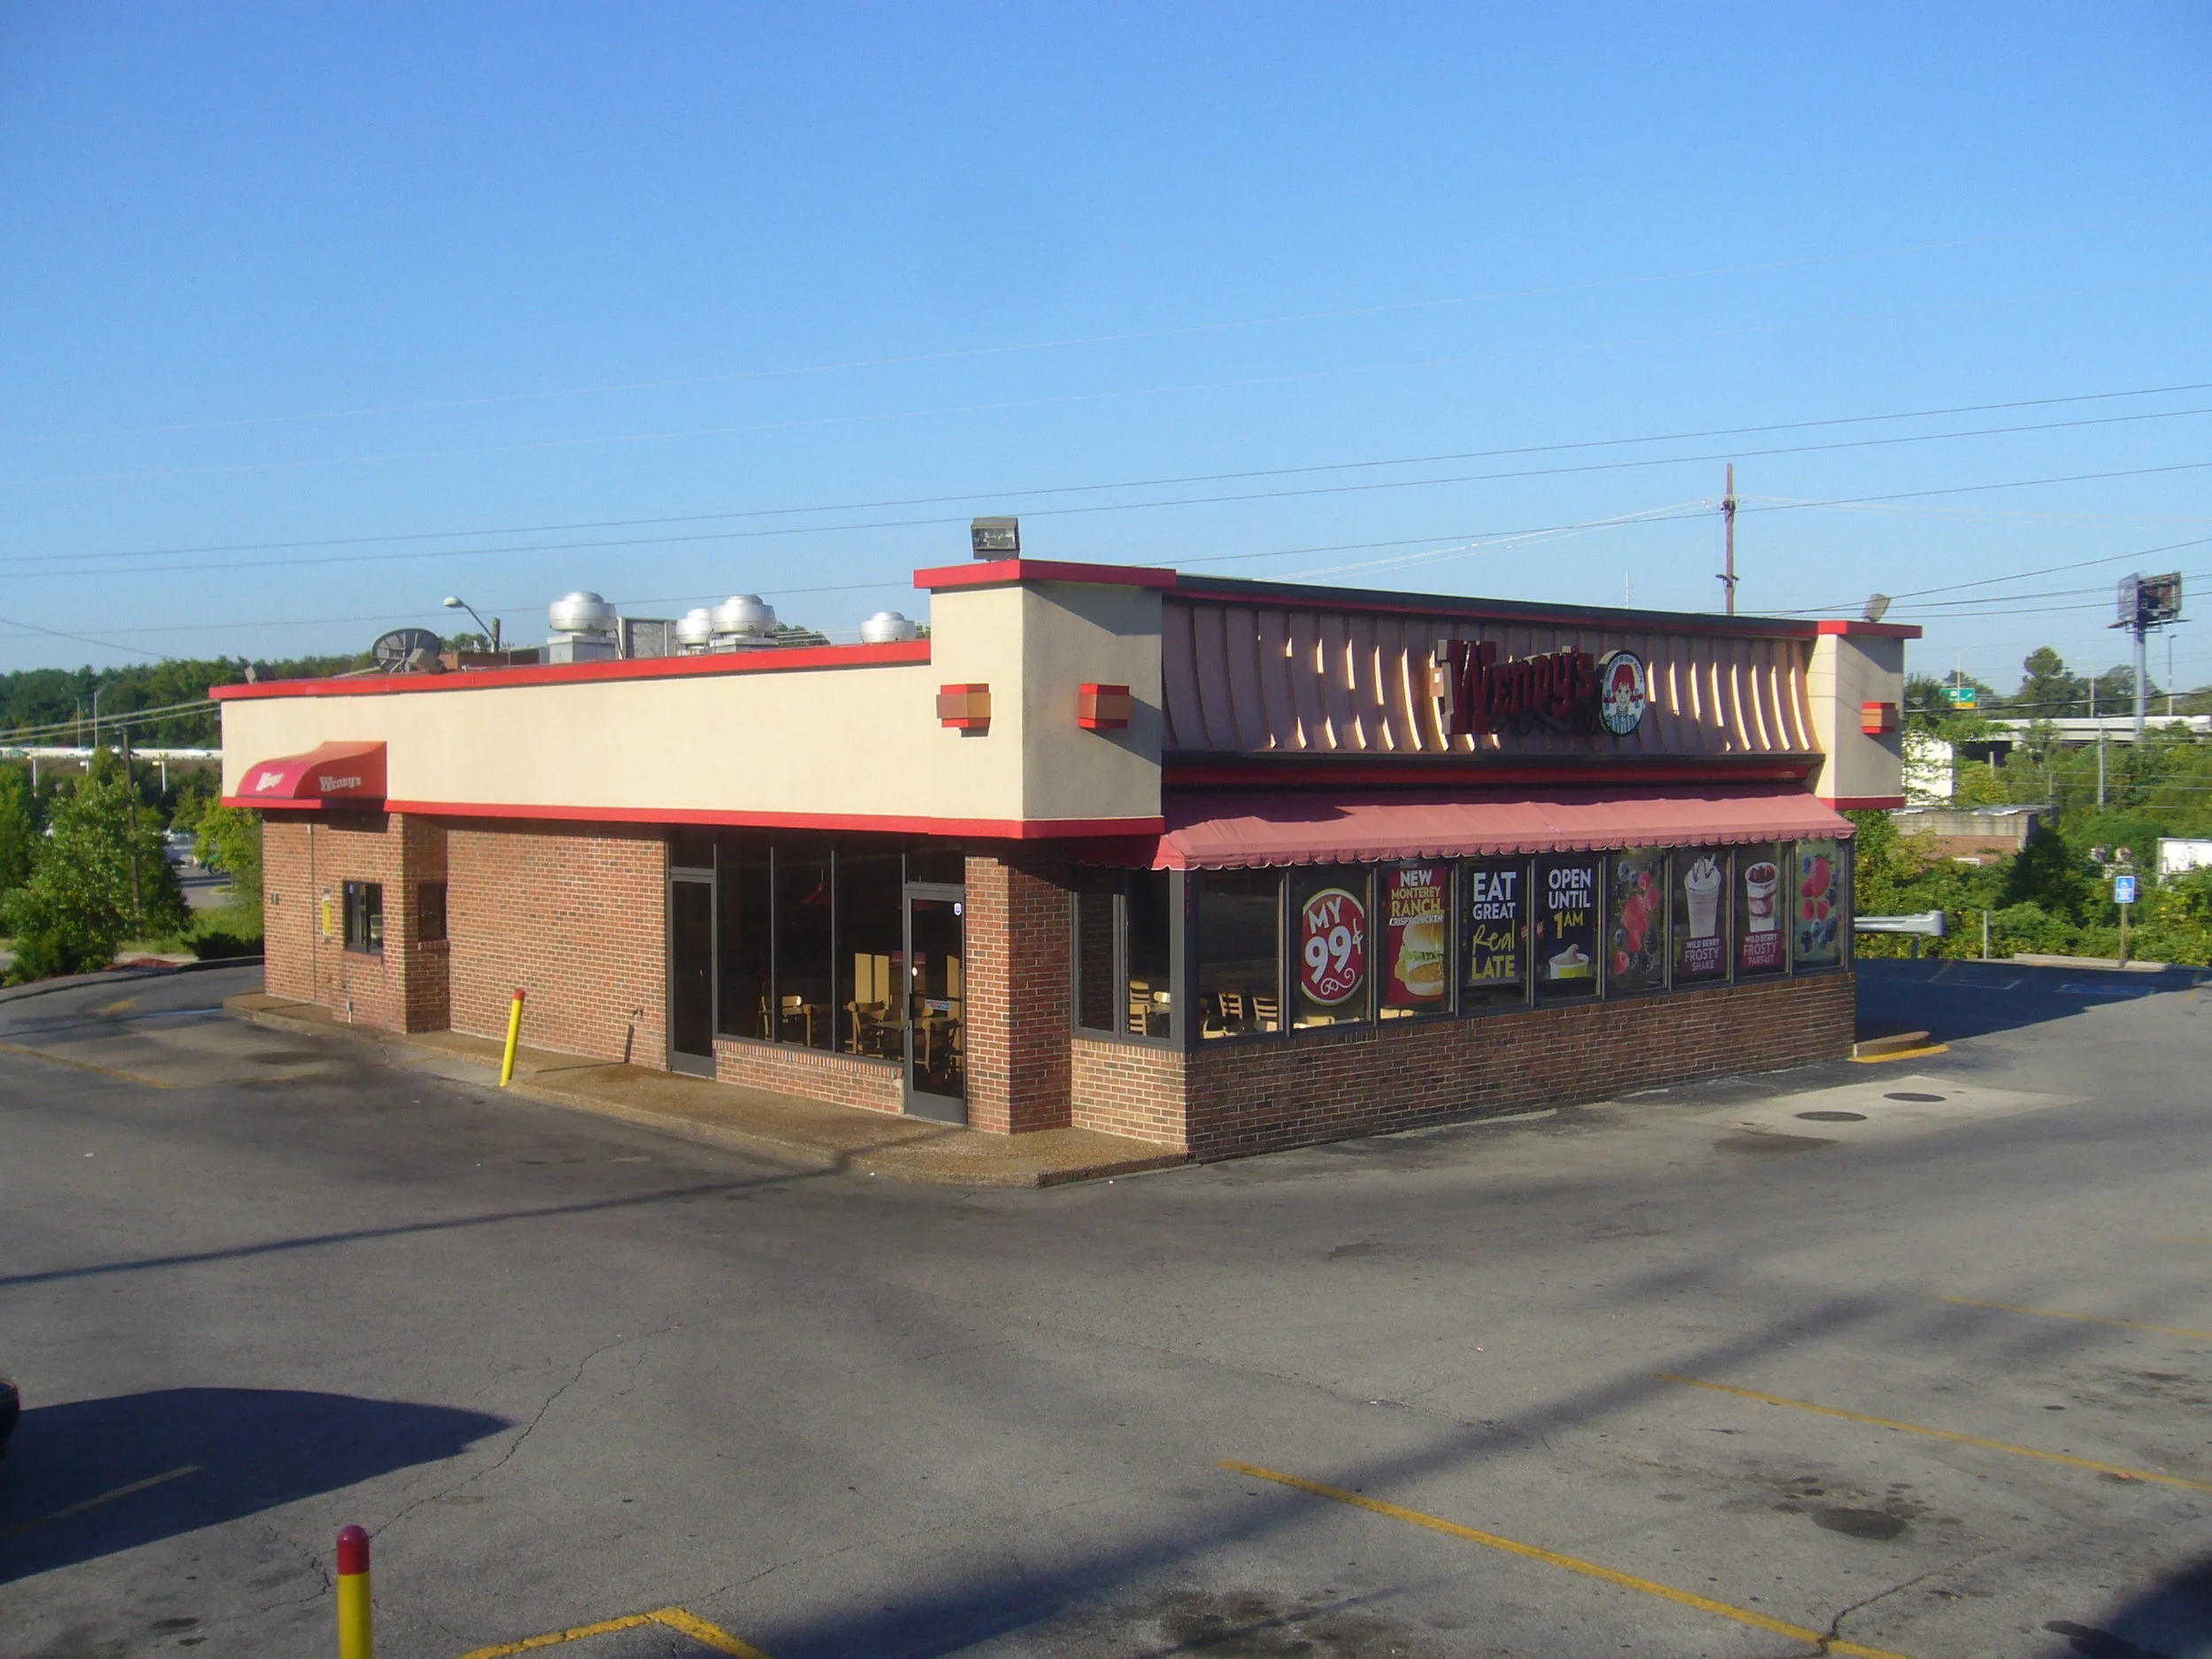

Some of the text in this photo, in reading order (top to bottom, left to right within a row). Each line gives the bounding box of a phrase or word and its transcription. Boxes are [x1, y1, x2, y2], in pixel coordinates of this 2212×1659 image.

[1400, 870, 1432, 887] NEW
[1473, 872, 1517, 902] EAT
[1548, 868, 1592, 890] OPEN
[1391, 886, 1441, 901] MONTEREY
[1548, 890, 1592, 910] UNTIL
[1308, 896, 1342, 934] MY
[1391, 897, 1441, 918] RANCH
[1472, 902, 1516, 921] GREAT
[1472, 918, 1516, 956] Real
[1685, 947, 1720, 963] FROSTY
[1744, 941, 1778, 956] FROSTY
[1471, 955, 1516, 980] LATE
